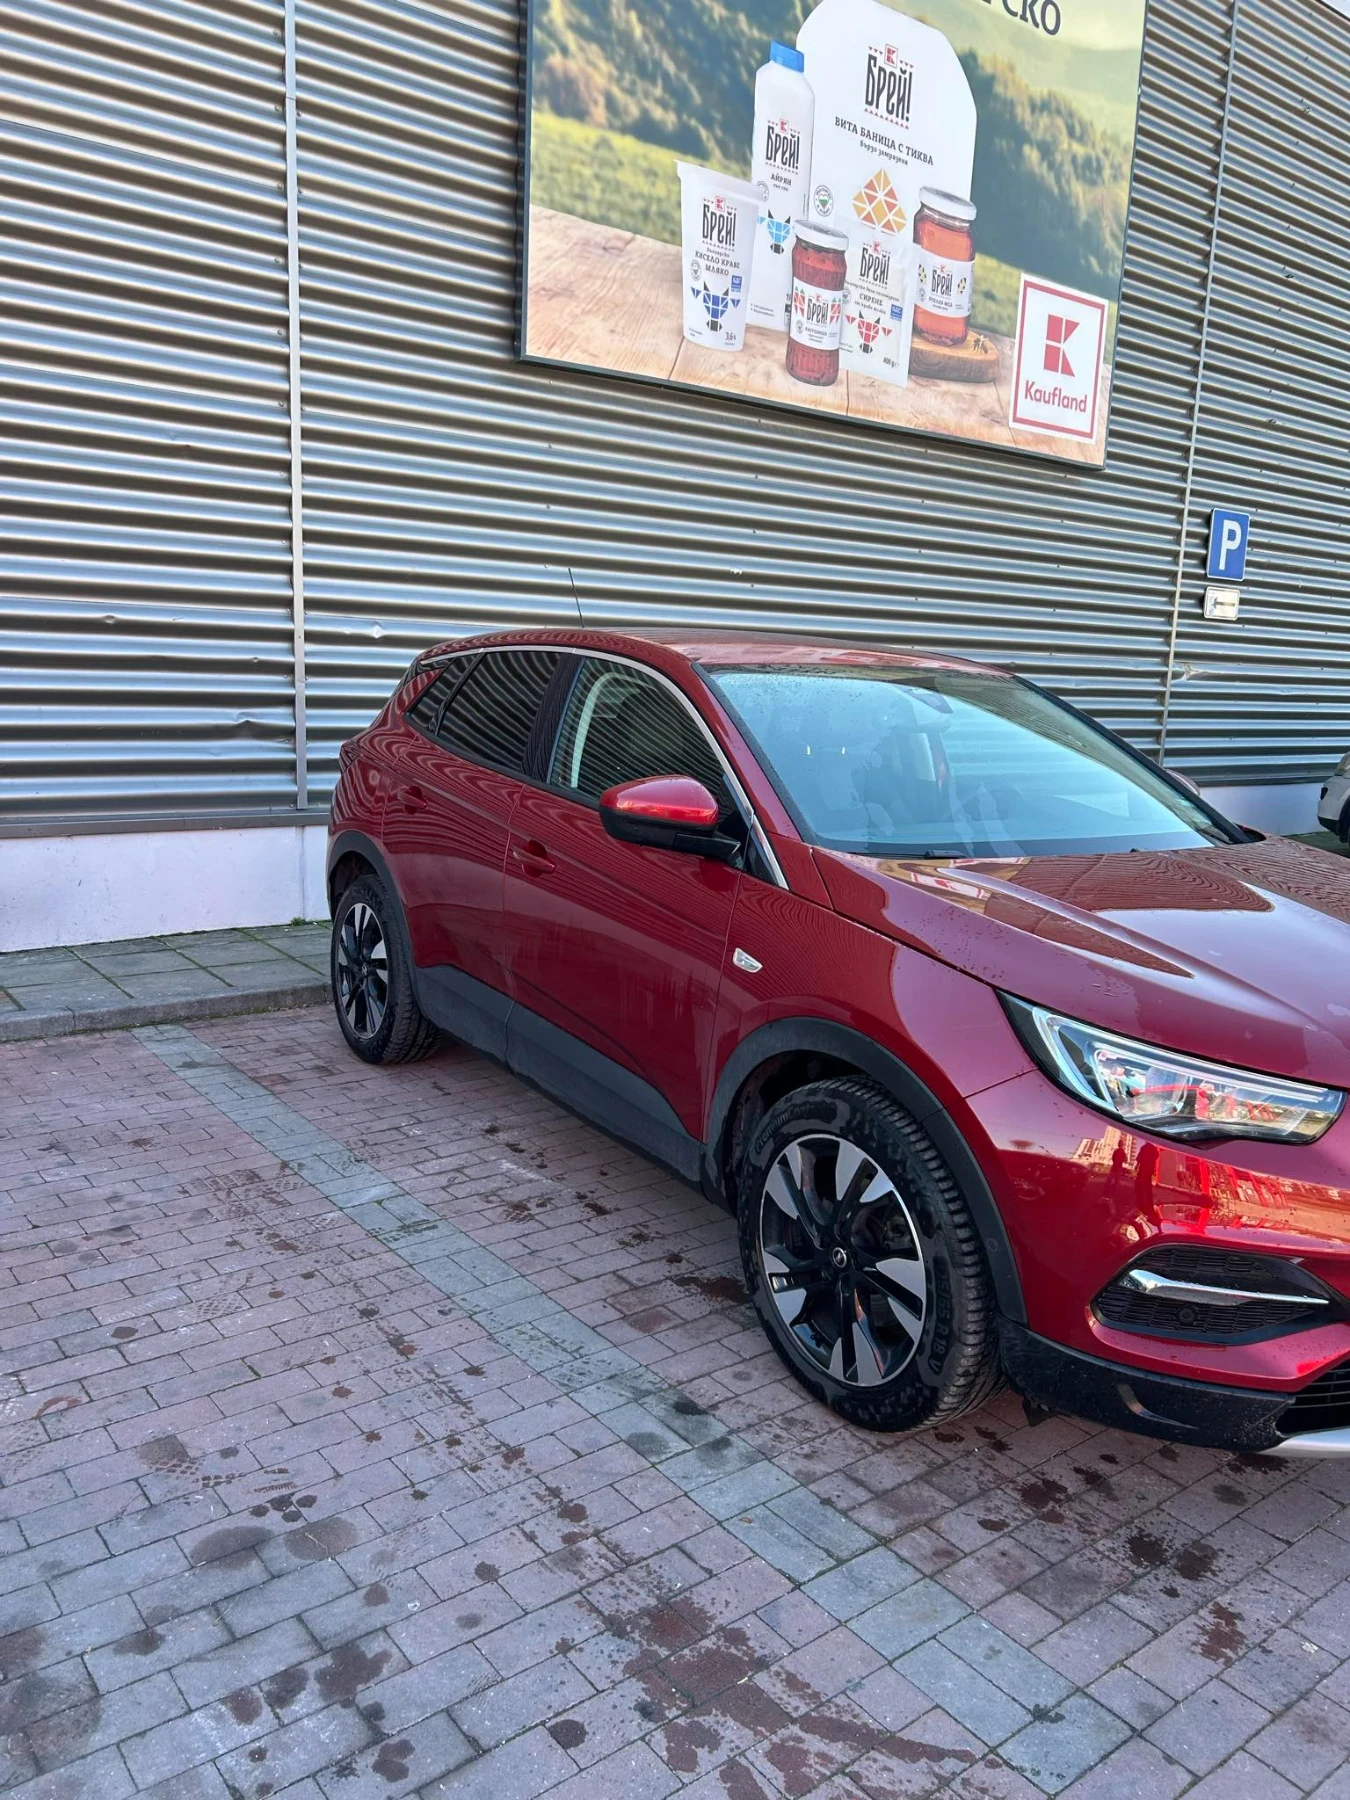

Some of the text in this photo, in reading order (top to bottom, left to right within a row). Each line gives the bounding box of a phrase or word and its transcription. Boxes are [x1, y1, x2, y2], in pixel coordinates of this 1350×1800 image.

[865, 53, 913, 122] Брей!
[766, 125, 800, 170] Брей!
[835, 116, 934, 165] ВИТА БАНИЦА С ТИКВА
[702, 203, 736, 247] Брей!
[695, 250, 741, 269] КИСЕЛО КРАВЕ
[705, 264, 729, 276] МЛЯКО
[860, 247, 890, 285] Брей!
[860, 293, 884, 306] СИРЕНЕ
[932, 269, 953, 296] Брей!
[807, 298, 829, 325] Брей!
[1024, 379, 1088, 413] Kaufland
[1218, 519, 1242, 571] P
